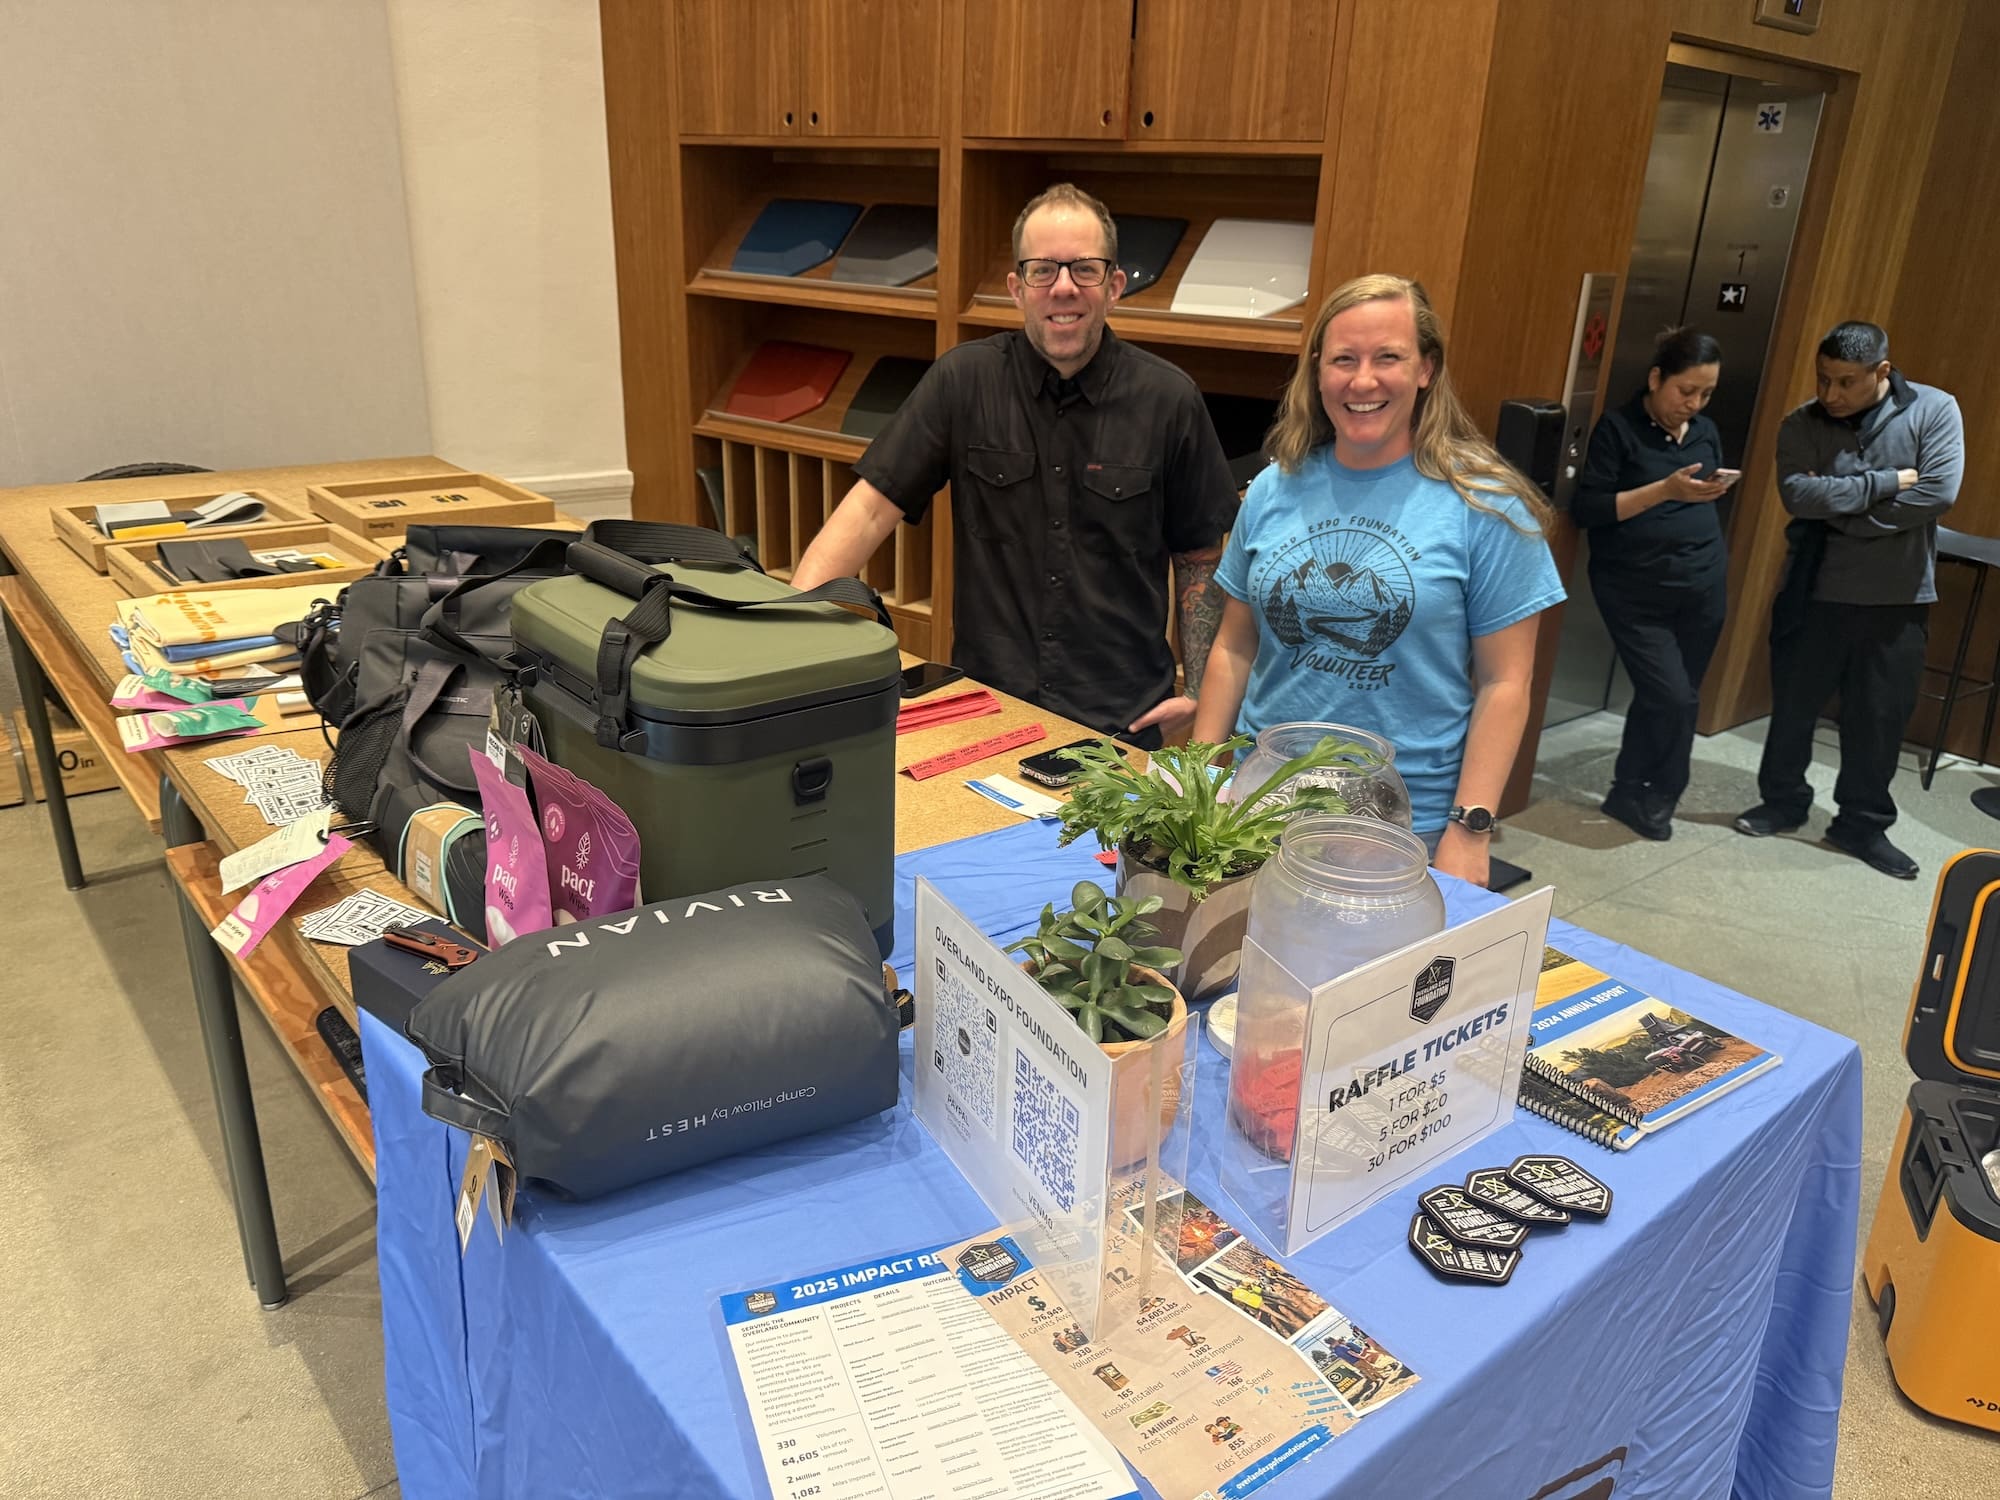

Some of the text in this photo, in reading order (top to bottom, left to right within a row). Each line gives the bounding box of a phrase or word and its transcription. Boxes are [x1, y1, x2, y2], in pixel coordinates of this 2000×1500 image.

[1251, 515, 1423, 601] OVERLAND EXPO FOUNDATION
[1290, 646, 1396, 686] VOLUNTEER
[561, 864, 596, 902] pact
[546, 888, 793, 957] RIVIAN
[935, 926, 1088, 1089] OVERLAND EXPO FOUNDATION
[1414, 985, 1449, 1009] FOUNDATION
[1531, 985, 1629, 1031] 2024 ANNUAL REPORT
[1329, 1048, 1417, 1114] RAFFLE
[1423, 1002, 1508, 1063] TICKETS
[1388, 1070, 1447, 1112] 1 FOR $5
[645, 1086, 817, 1142] Camp Pillow by HEST
[947, 1094, 970, 1127] PAYPAL
[1379, 1093, 1448, 1143] 5 FOR $20
[1367, 1113, 1452, 1173] 30 FOR $100
[1028, 1192, 1053, 1230] VENMO
[1443, 1208, 1484, 1220] OVERLAND
[791, 1252, 943, 1300] 2025 IMPACT RE
[972, 1255, 1014, 1278] FOUNDATION
[1106, 1266, 1134, 1286] 12
[922, 1274, 955, 1287] OUTCOMES
[987, 1276, 1040, 1306] IMPACT
[830, 1298, 861, 1310] PROJECTS
[873, 1288, 900, 1299] DETAILS
[742, 1324, 779, 1337] OVERLAND
[779, 1314, 820, 1328] COMMUNITY
[1031, 1306, 1064, 1325] $76,949
[1135, 1302, 1193, 1336] Trash Removed
[1136, 1301, 1179, 1327] 64,605 Lbs
[740, 1321, 770, 1332] SERVING
[1028, 1321, 1055, 1336] Grants
[1069, 1345, 1113, 1371] Volunteers
[1074, 1346, 1092, 1358] 330
[1171, 1335, 1245, 1381] Trail Miles Improved
[1188, 1343, 1213, 1360] 1,082
[1212, 1368, 1275, 1408] Veterans Served
[1227, 1375, 1245, 1388] 166
[1101, 1381, 1165, 1421] Kiosks Installed
[1117, 1388, 1135, 1401] 165
[815, 1426, 847, 1439] Volunteers
[1137, 1413, 1199, 1455] Acres Improved
[1140, 1415, 1179, 1440] 2 Million
[776, 1438, 796, 1450] 330
[822, 1447, 847, 1458] removed
[838, 1437, 853, 1445] trash
[1214, 1431, 1276, 1473] Kids' Education
[1227, 1437, 1246, 1451] 855
[781, 1449, 819, 1467] 64,605
[826, 1463, 843, 1471] Acres
[1235, 1433, 1320, 1490] overlandexpofoundation.org
[786, 1475, 793, 1484] 2
[831, 1478, 848, 1487] Miles
[864, 1486, 884, 1495] served
[790, 1485, 822, 1500] 1,082
